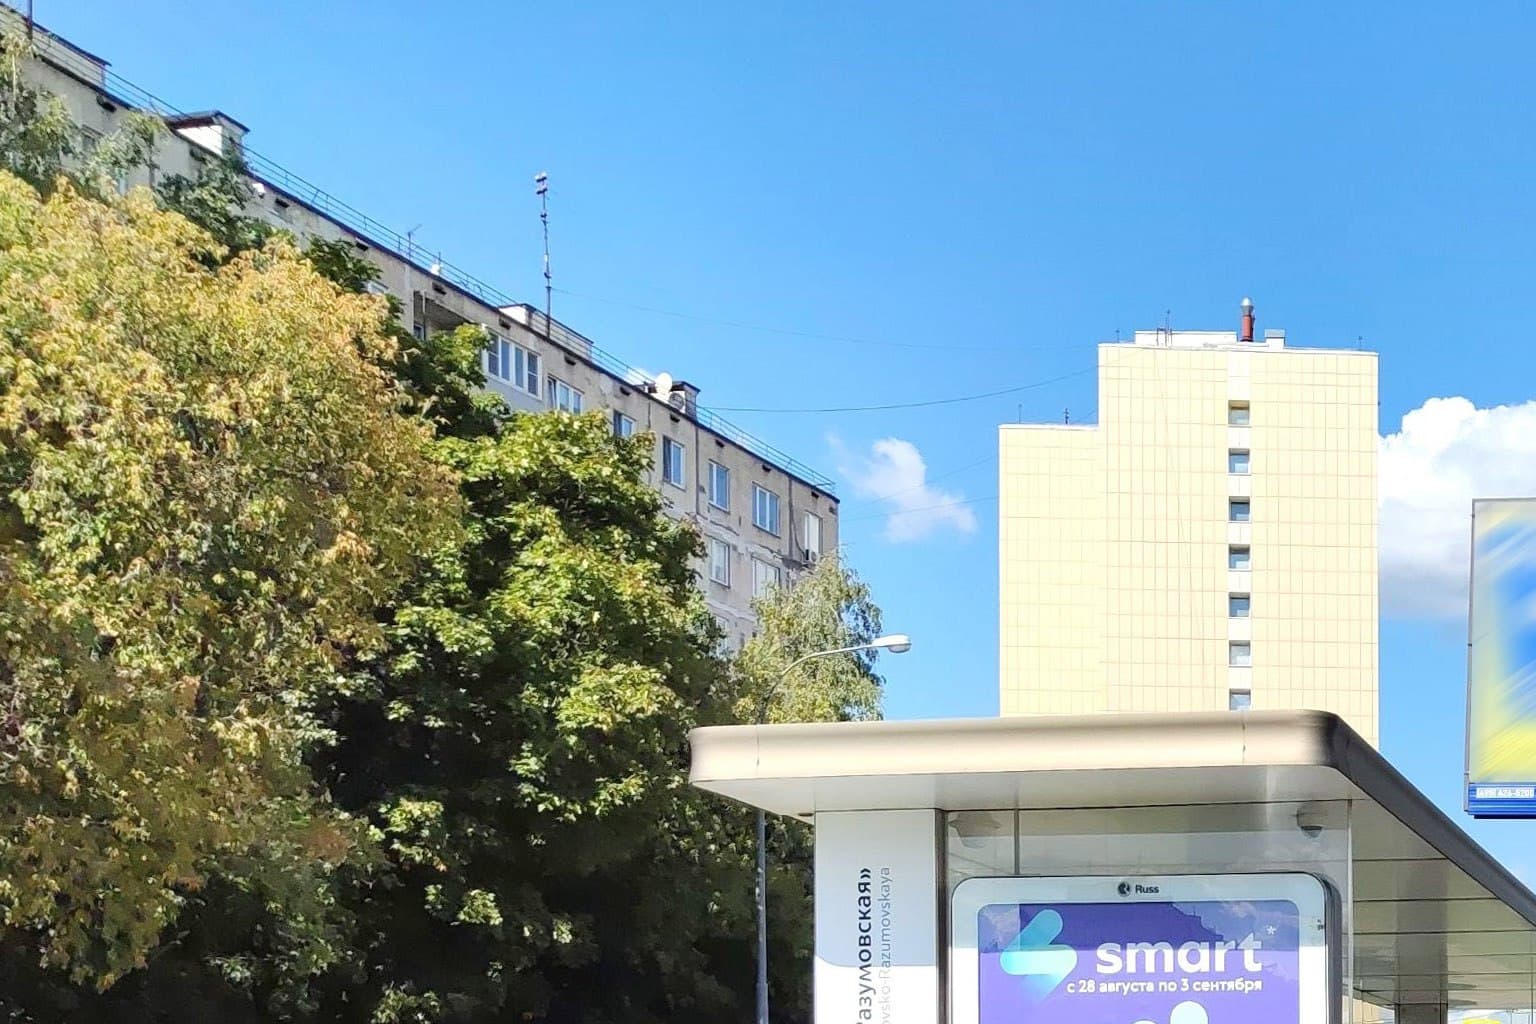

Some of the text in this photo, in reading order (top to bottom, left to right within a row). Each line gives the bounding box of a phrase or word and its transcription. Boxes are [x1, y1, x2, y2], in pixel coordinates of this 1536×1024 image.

[1135, 884, 1160, 895] Russ
[1067, 978, 1262, 996] с 28 августа по 3 сентября
